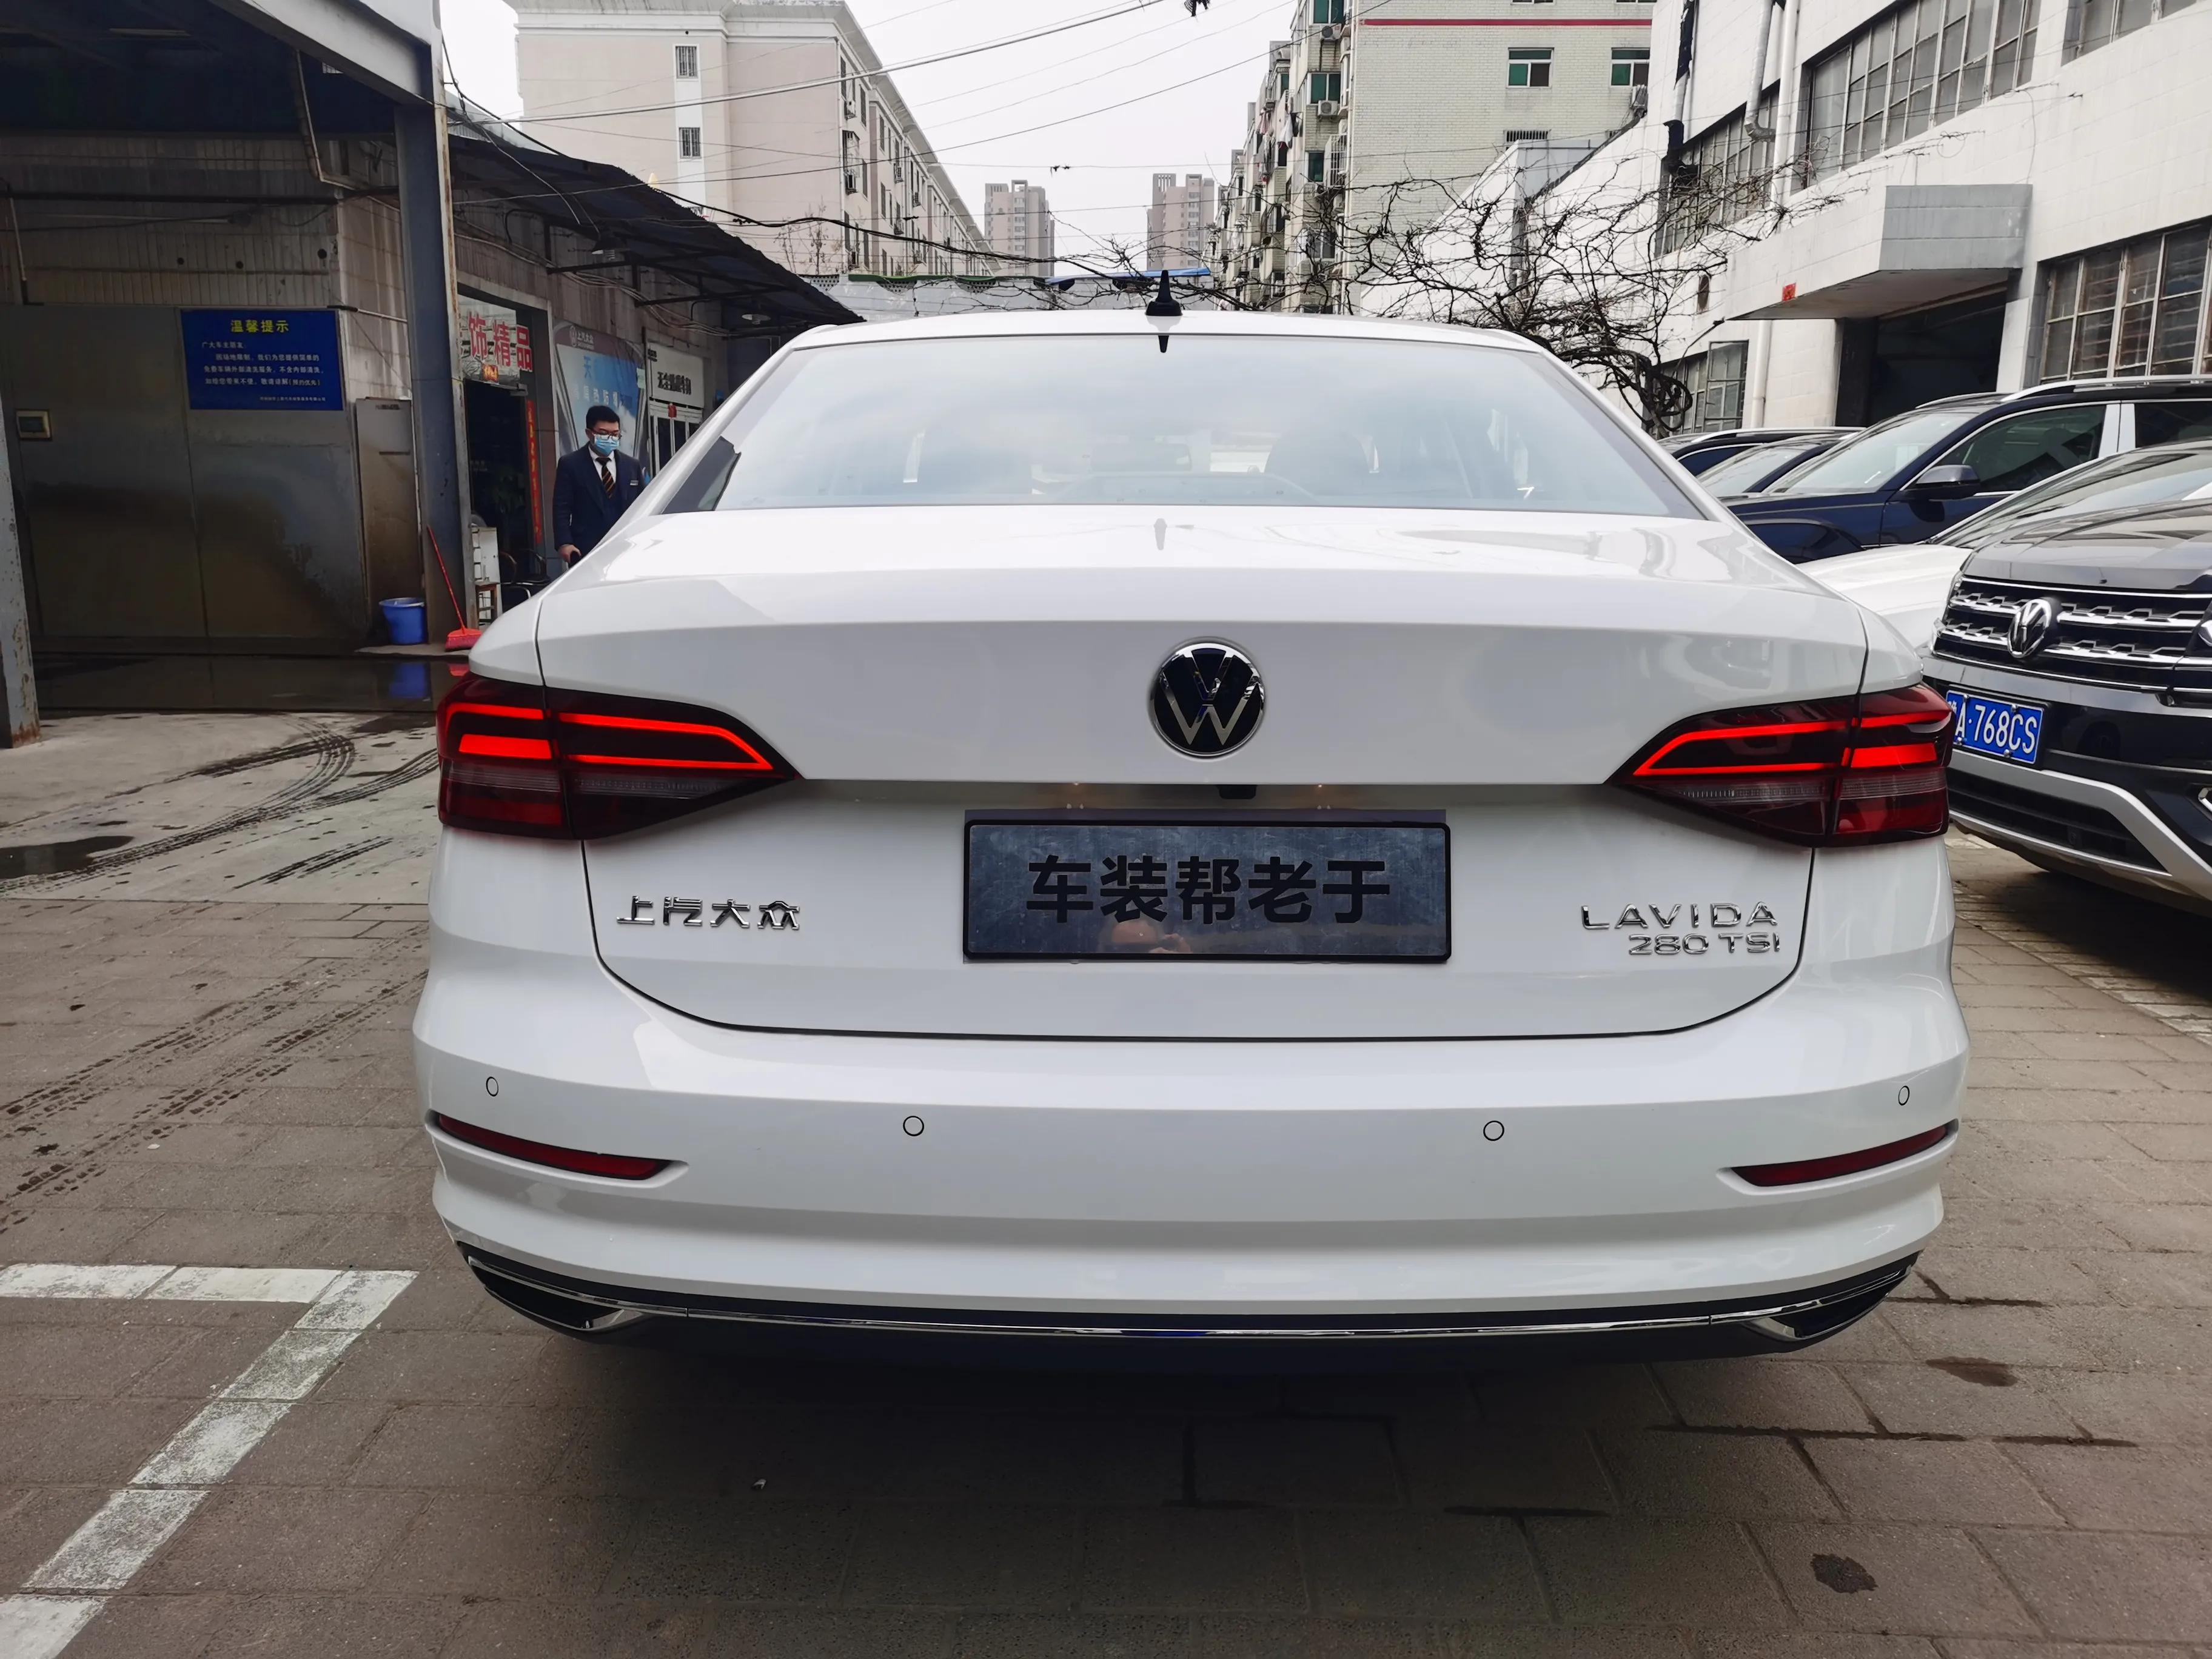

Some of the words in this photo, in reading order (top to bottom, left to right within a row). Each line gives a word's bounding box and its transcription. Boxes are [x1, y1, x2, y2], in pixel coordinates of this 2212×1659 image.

[230, 319, 289, 333] 温馨提示
[460, 311, 533, 372] 饰精品
[1026, 854, 1391, 925] 车装帮老于
[617, 896, 800, 930] 上汽大众
[1581, 901, 1778, 930] LAVIDA
[1629, 933, 1709, 955] 280
[1718, 932, 1781, 953] TSI
